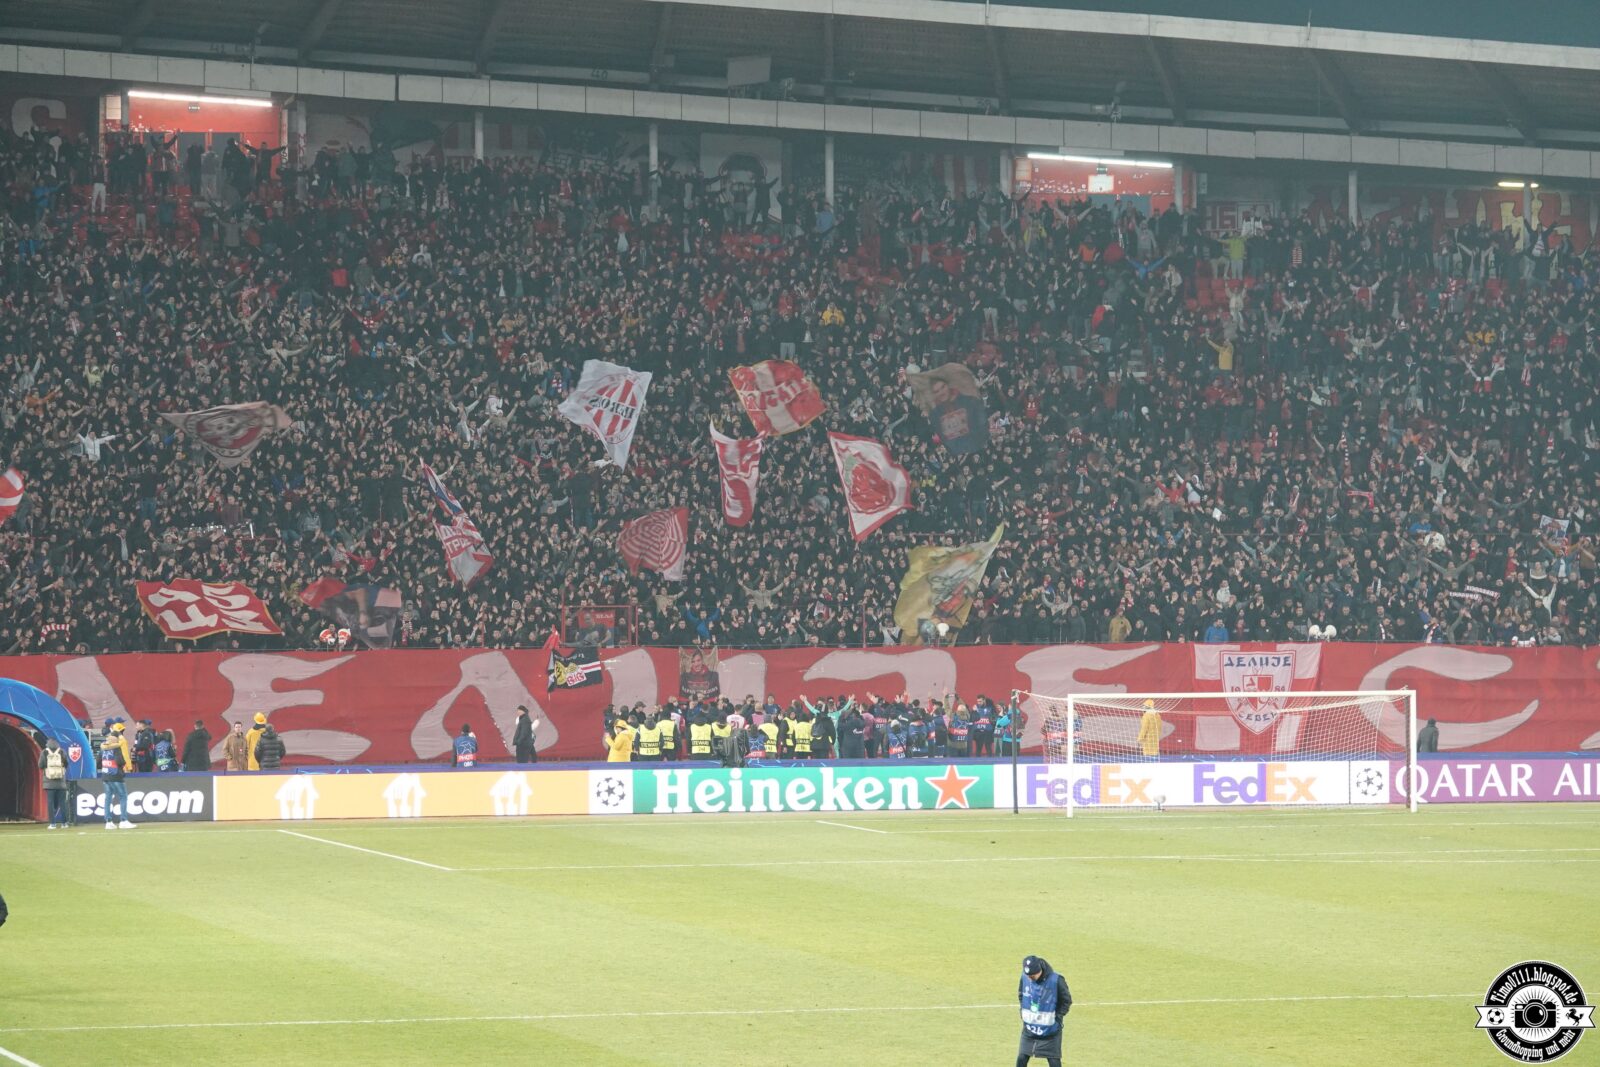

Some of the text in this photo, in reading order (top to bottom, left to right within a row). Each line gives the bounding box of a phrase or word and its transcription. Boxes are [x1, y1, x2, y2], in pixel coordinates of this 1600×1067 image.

[1223, 655, 1292, 667] ДЕЛИЈЕ
[652, 767, 923, 813] Heineken
[1026, 765, 1153, 806] FedEx
[1193, 763, 1319, 804] FedEx
[1395, 762, 1600, 803] QATAR AI
